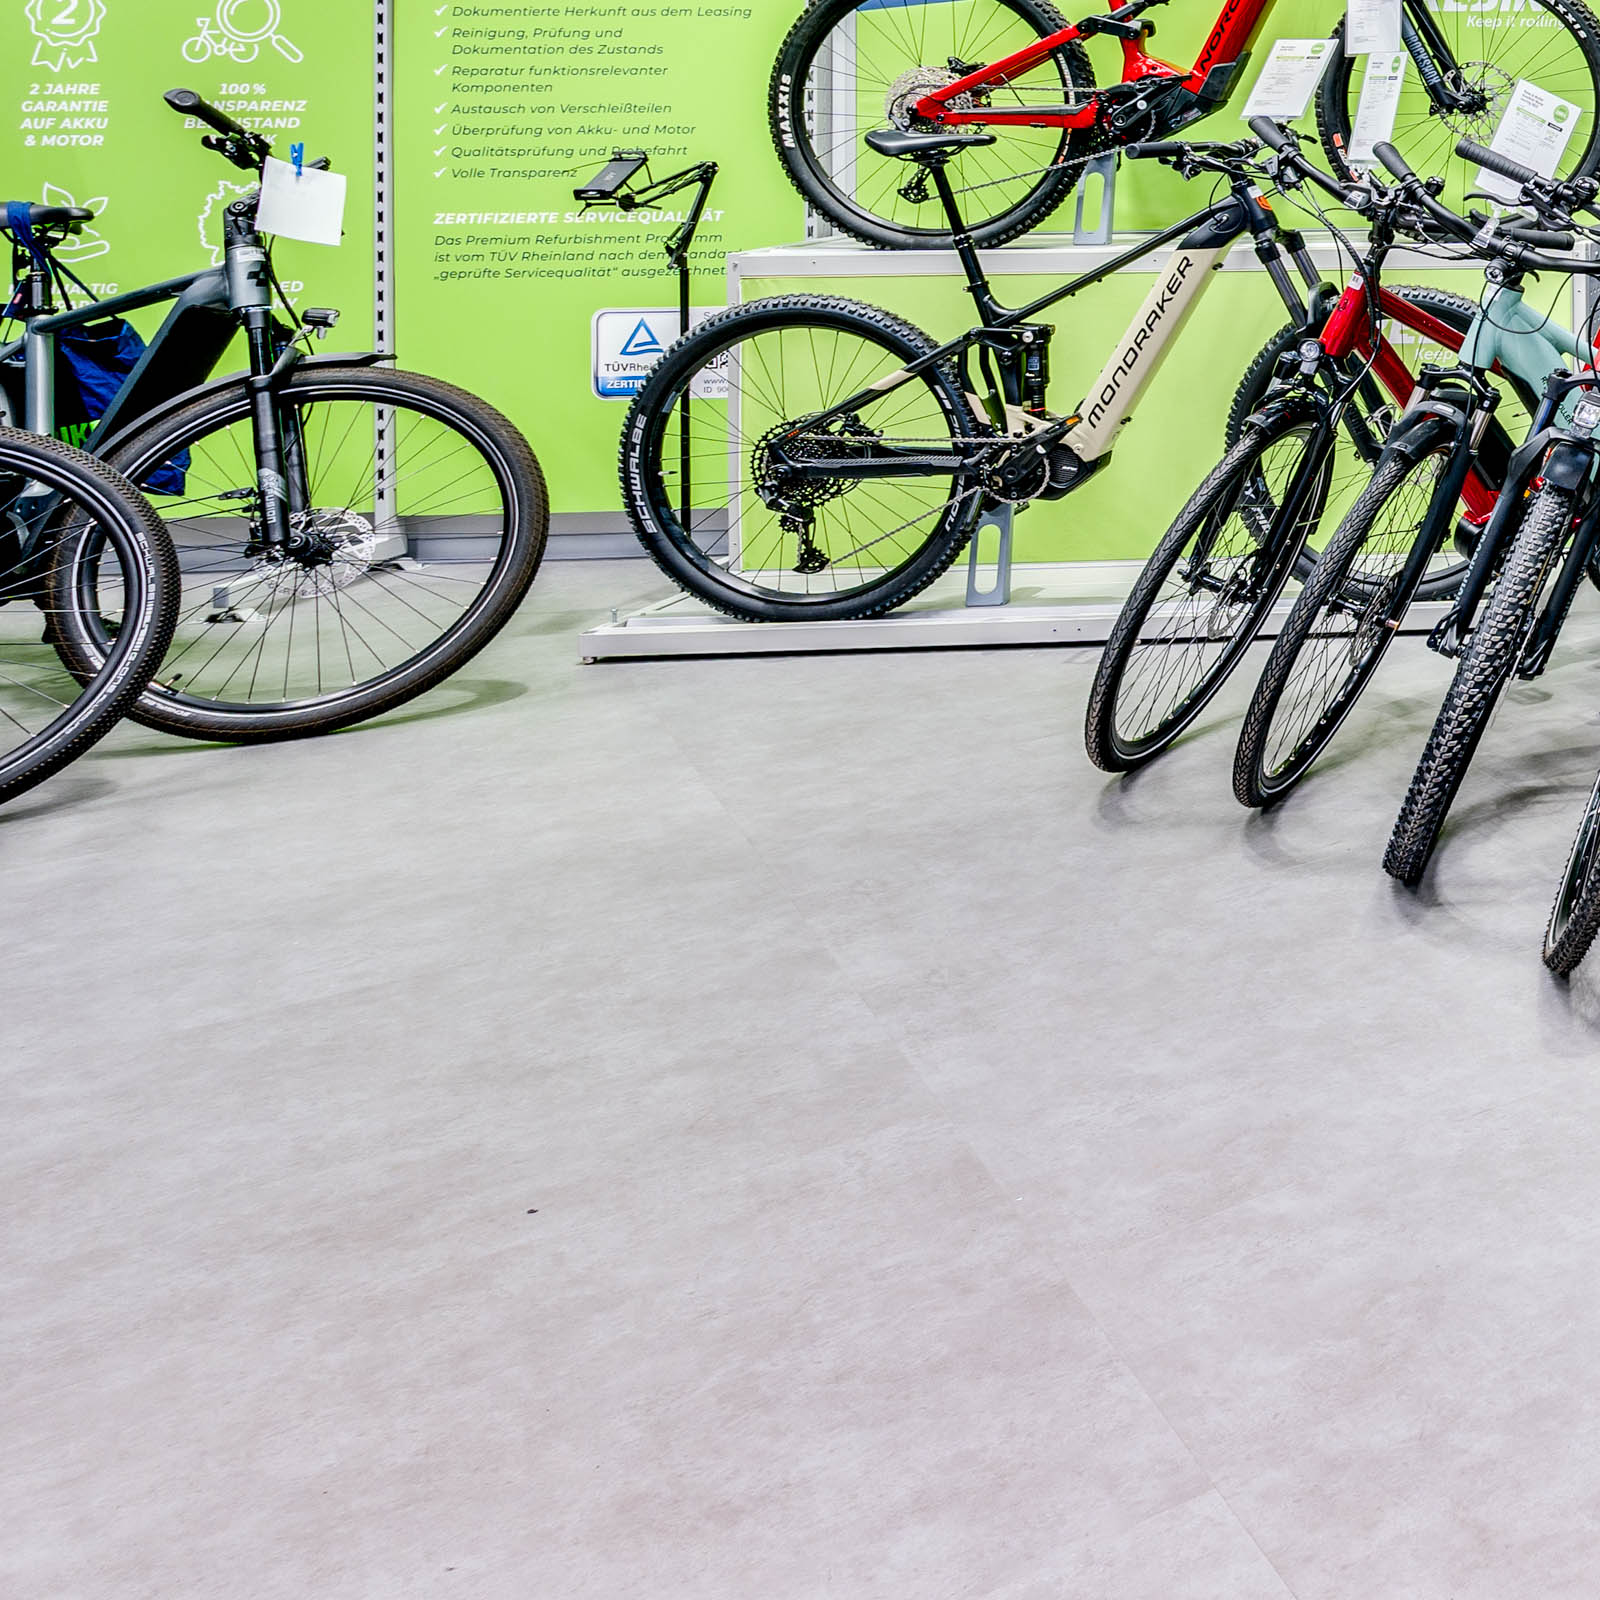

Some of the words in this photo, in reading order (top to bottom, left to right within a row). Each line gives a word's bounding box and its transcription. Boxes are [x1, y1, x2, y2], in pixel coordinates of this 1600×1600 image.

[452, 6, 559, 17] Dokumentierte
[564, 6, 627, 17] Herkunft
[632, 8, 656, 17] aus
[660, 6, 692, 17] dem
[697, 6, 752, 19] Leasing
[1466, 15, 1495, 30] Keep
[452, 27, 528, 40] Reinigung,
[533, 27, 590, 40] Prüfung
[595, 27, 623, 38] und
[452, 44, 564, 55] Dokumentation
[569, 44, 594, 55] des
[598, 44, 664, 55] Zustands
[1405, 31, 1442, 86] ROCKSHOX
[452, 65, 523, 78] Reparatur
[528, 65, 668, 76] funktionsrelevanter
[29, 84, 40, 95] 2
[43, 84, 100, 95] JAHRE
[219, 83, 250, 94] 100
[252, 84, 267, 94] %
[452, 82, 553, 95] Komponenten
[21, 101, 108, 112] GARANTIE
[451, 103, 523, 114] Austausch
[528, 105, 556, 114] von
[560, 102, 672, 114] Verschleißteilen
[778, 73, 795, 149] MAXXIS
[21, 118, 56, 129] AUF
[59, 118, 108, 129] AKKU
[451, 123, 543, 137] Überprüfung
[549, 127, 573, 136] von
[576, 124, 618, 136] Akku-
[622, 124, 650, 136] und
[654, 124, 696, 136] Motor
[24, 135, 36, 146] &
[41, 135, 104, 146] MOTOR
[451, 145, 574, 159] Qualitätsprüfung
[578, 146, 607, 157] und
[452, 168, 485, 178] Volle
[489, 168, 578, 180] Transparenz
[434, 212, 559, 225] ZERTIFIZIERTE
[563, 208, 725, 224] SERVICEQUALÄT
[434, 234, 462, 246] Das
[466, 234, 531, 245] Premium
[535, 233, 641, 245] Refurbishment
[434, 251, 450, 262] ist
[454, 253, 485, 262] vom
[489, 249, 518, 262] TÜV
[522, 249, 595, 261] Rheinland
[599, 249, 630, 261] nach
[638, 249, 670, 260] dem
[504, 266, 618, 279] Servicequalität“
[1088, 255, 1194, 429] MONDRAKER
[1414, 347, 1454, 362] Keep
[630, 413, 658, 534] SCHWALBE
